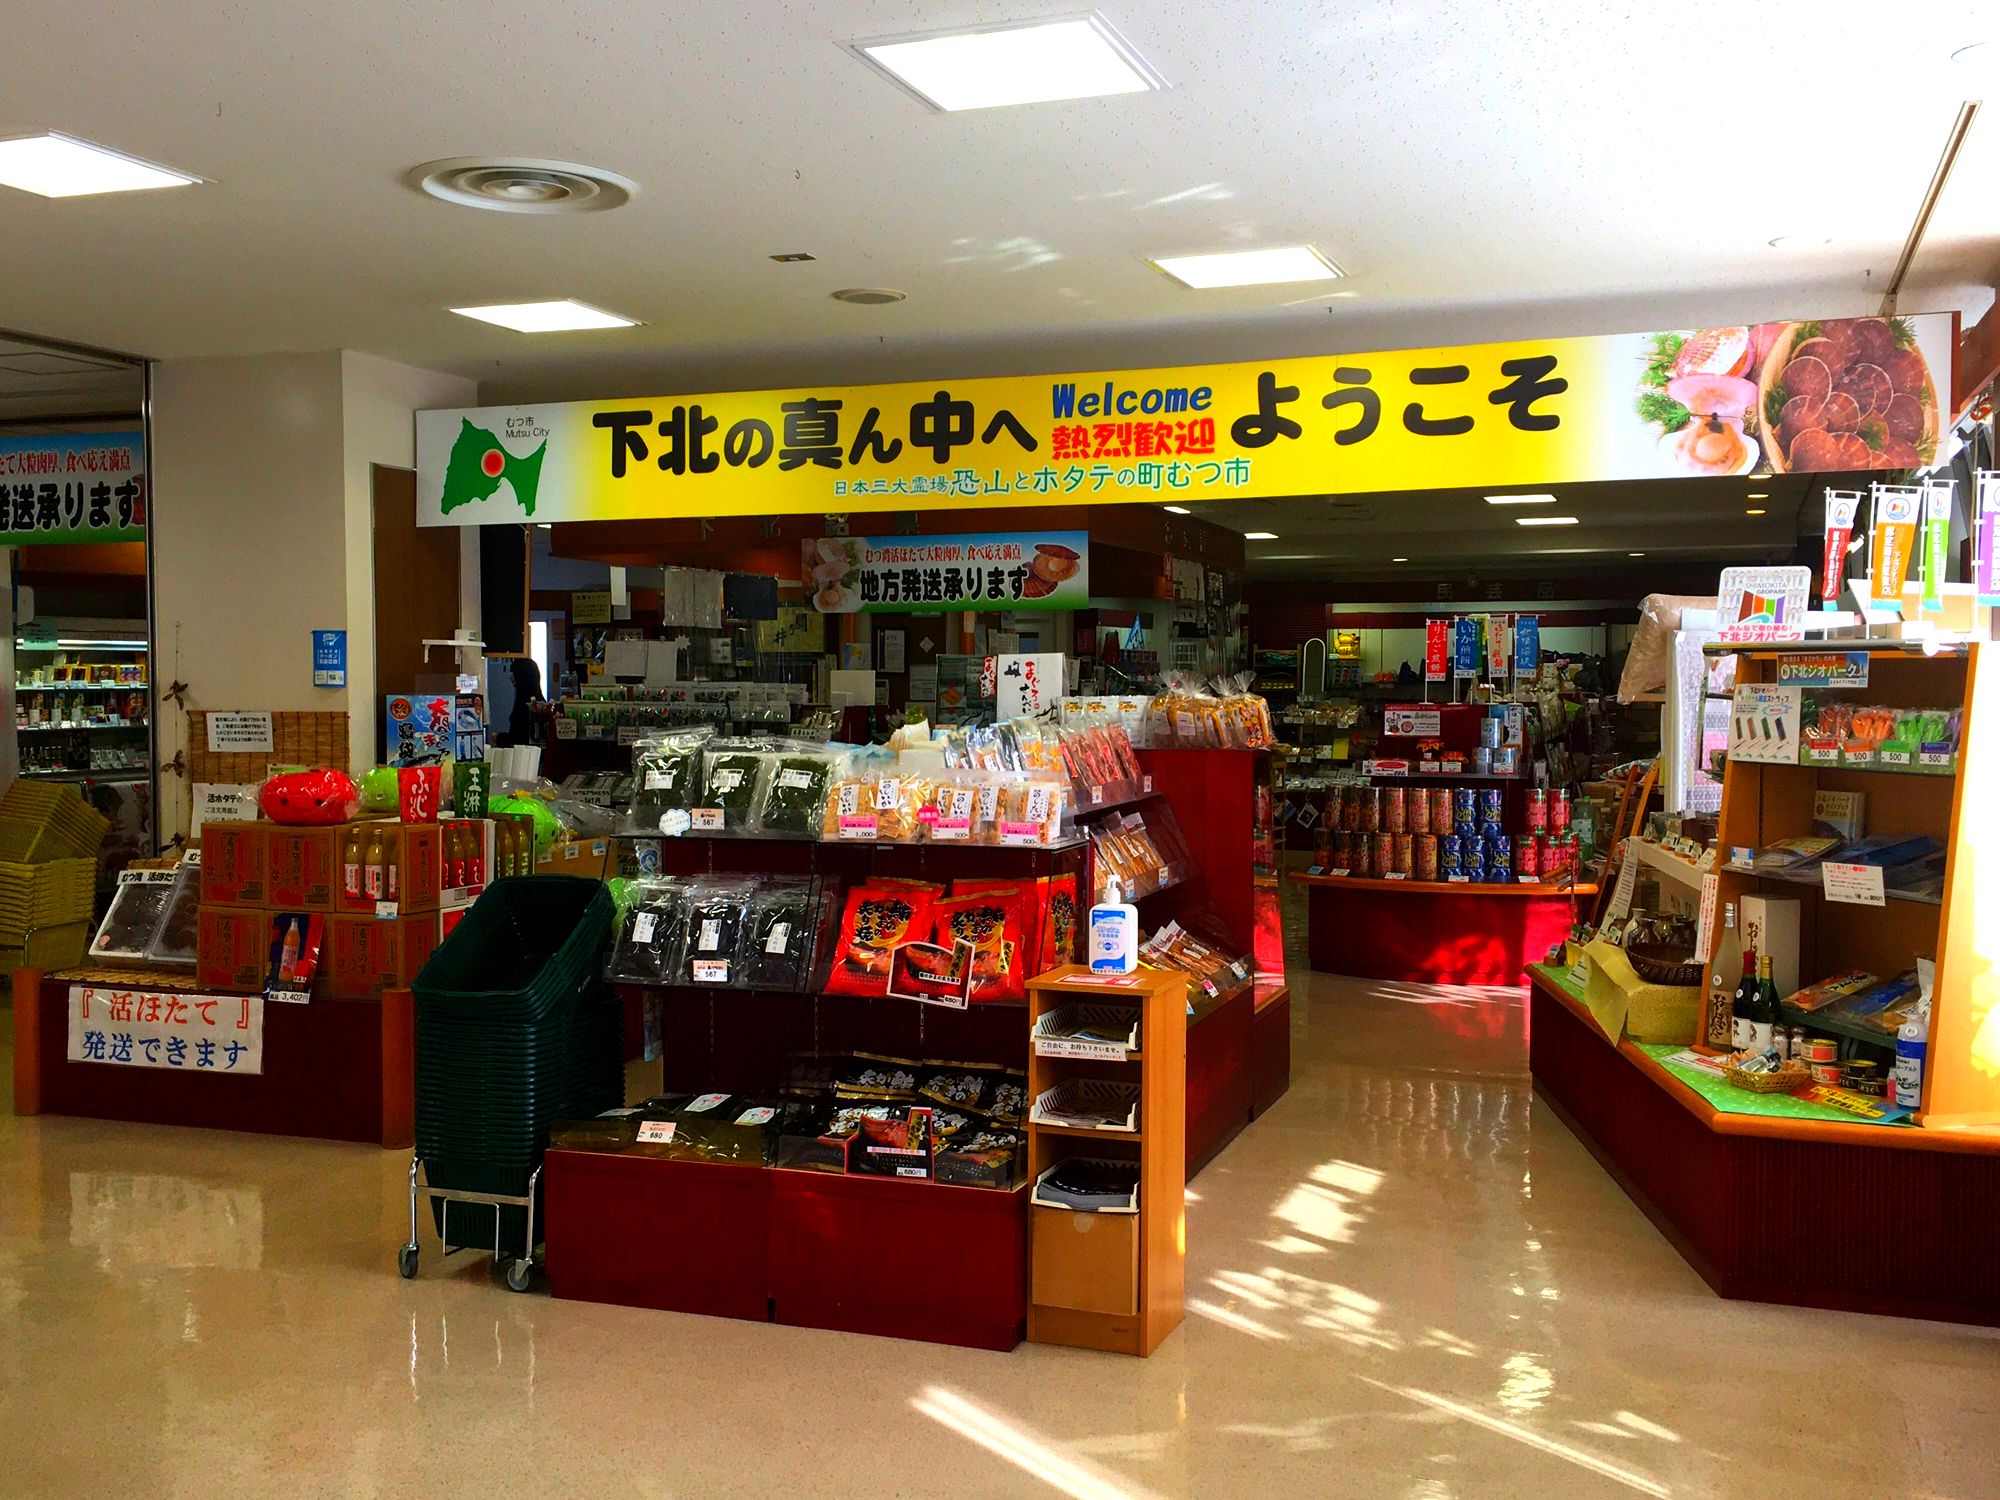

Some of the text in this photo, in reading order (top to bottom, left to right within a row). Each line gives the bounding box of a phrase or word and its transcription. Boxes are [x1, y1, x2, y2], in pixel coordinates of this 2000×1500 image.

[1052, 382, 1212, 419] Welcome
[1231, 355, 1569, 449] ようこそ
[505, 416, 535, 427] むつ市
[505, 427, 550, 439] Mutsu City
[592, 390, 1039, 478] 下北の真ん中へ
[1052, 417, 1215, 460] 熱烈歓迎
[833, 457, 1251, 497] 日本三大霊場恐山とホタテの町むつ市
[859, 566, 1029, 603] 地方発送承ります
[1718, 632, 1801, 642] 下北ジオパーク
[1790, 663, 1857, 679] 下北ジオパーク
[1019, 661, 1040, 714] まぐろ せんべい
[1817, 750, 1830, 758] 500
[1853, 752, 1867, 760] 500
[1889, 753, 1902, 761] 500
[1928, 755, 1942, 763] 500
[468, 767, 482, 812] 王林
[207, 794, 243, 803] 活ホタテの
[121, 872, 142, 883] むつ湾
[82, 1031, 249, 1070] 発送できます
